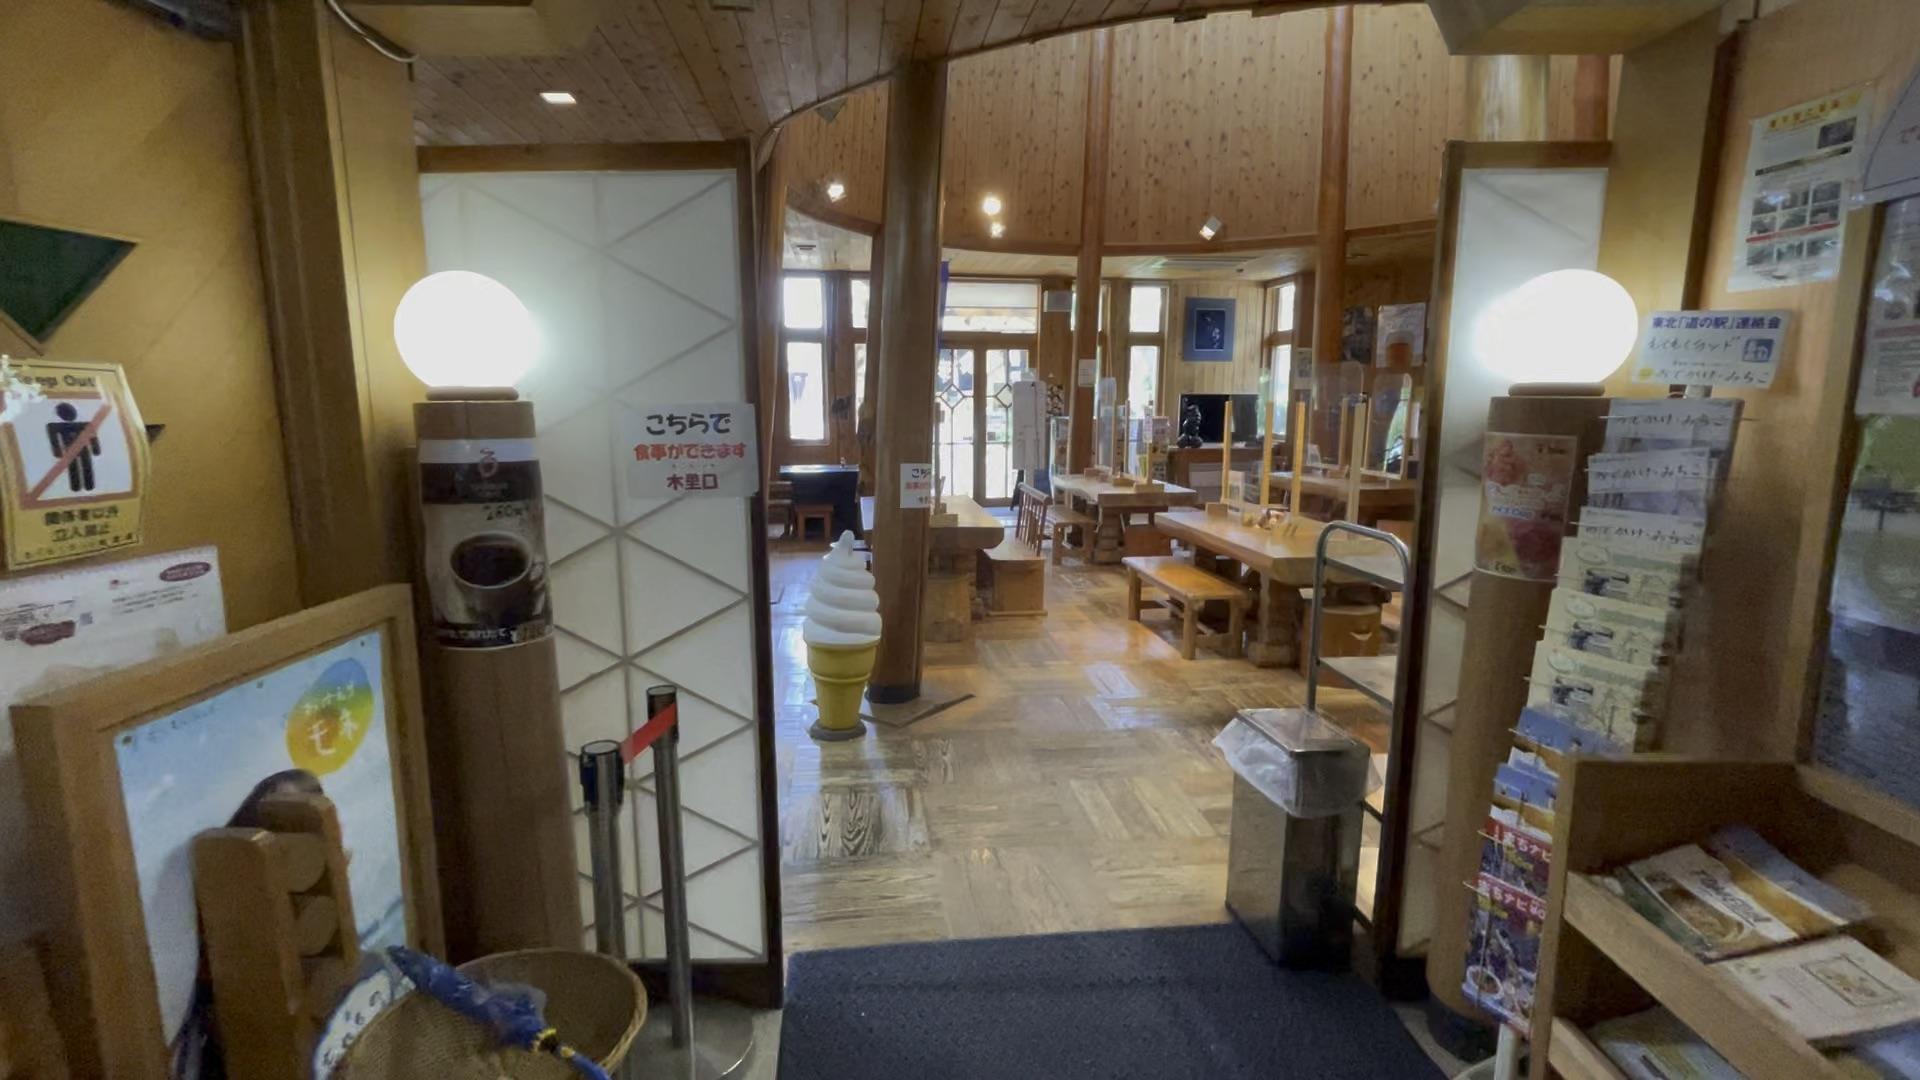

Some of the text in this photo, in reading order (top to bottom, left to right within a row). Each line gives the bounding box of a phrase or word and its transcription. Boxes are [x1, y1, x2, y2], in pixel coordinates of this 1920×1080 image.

[646, 412, 731, 435] こちらで
[633, 442, 747, 461] 食事ができます
[666, 473, 719, 491] 木里口
